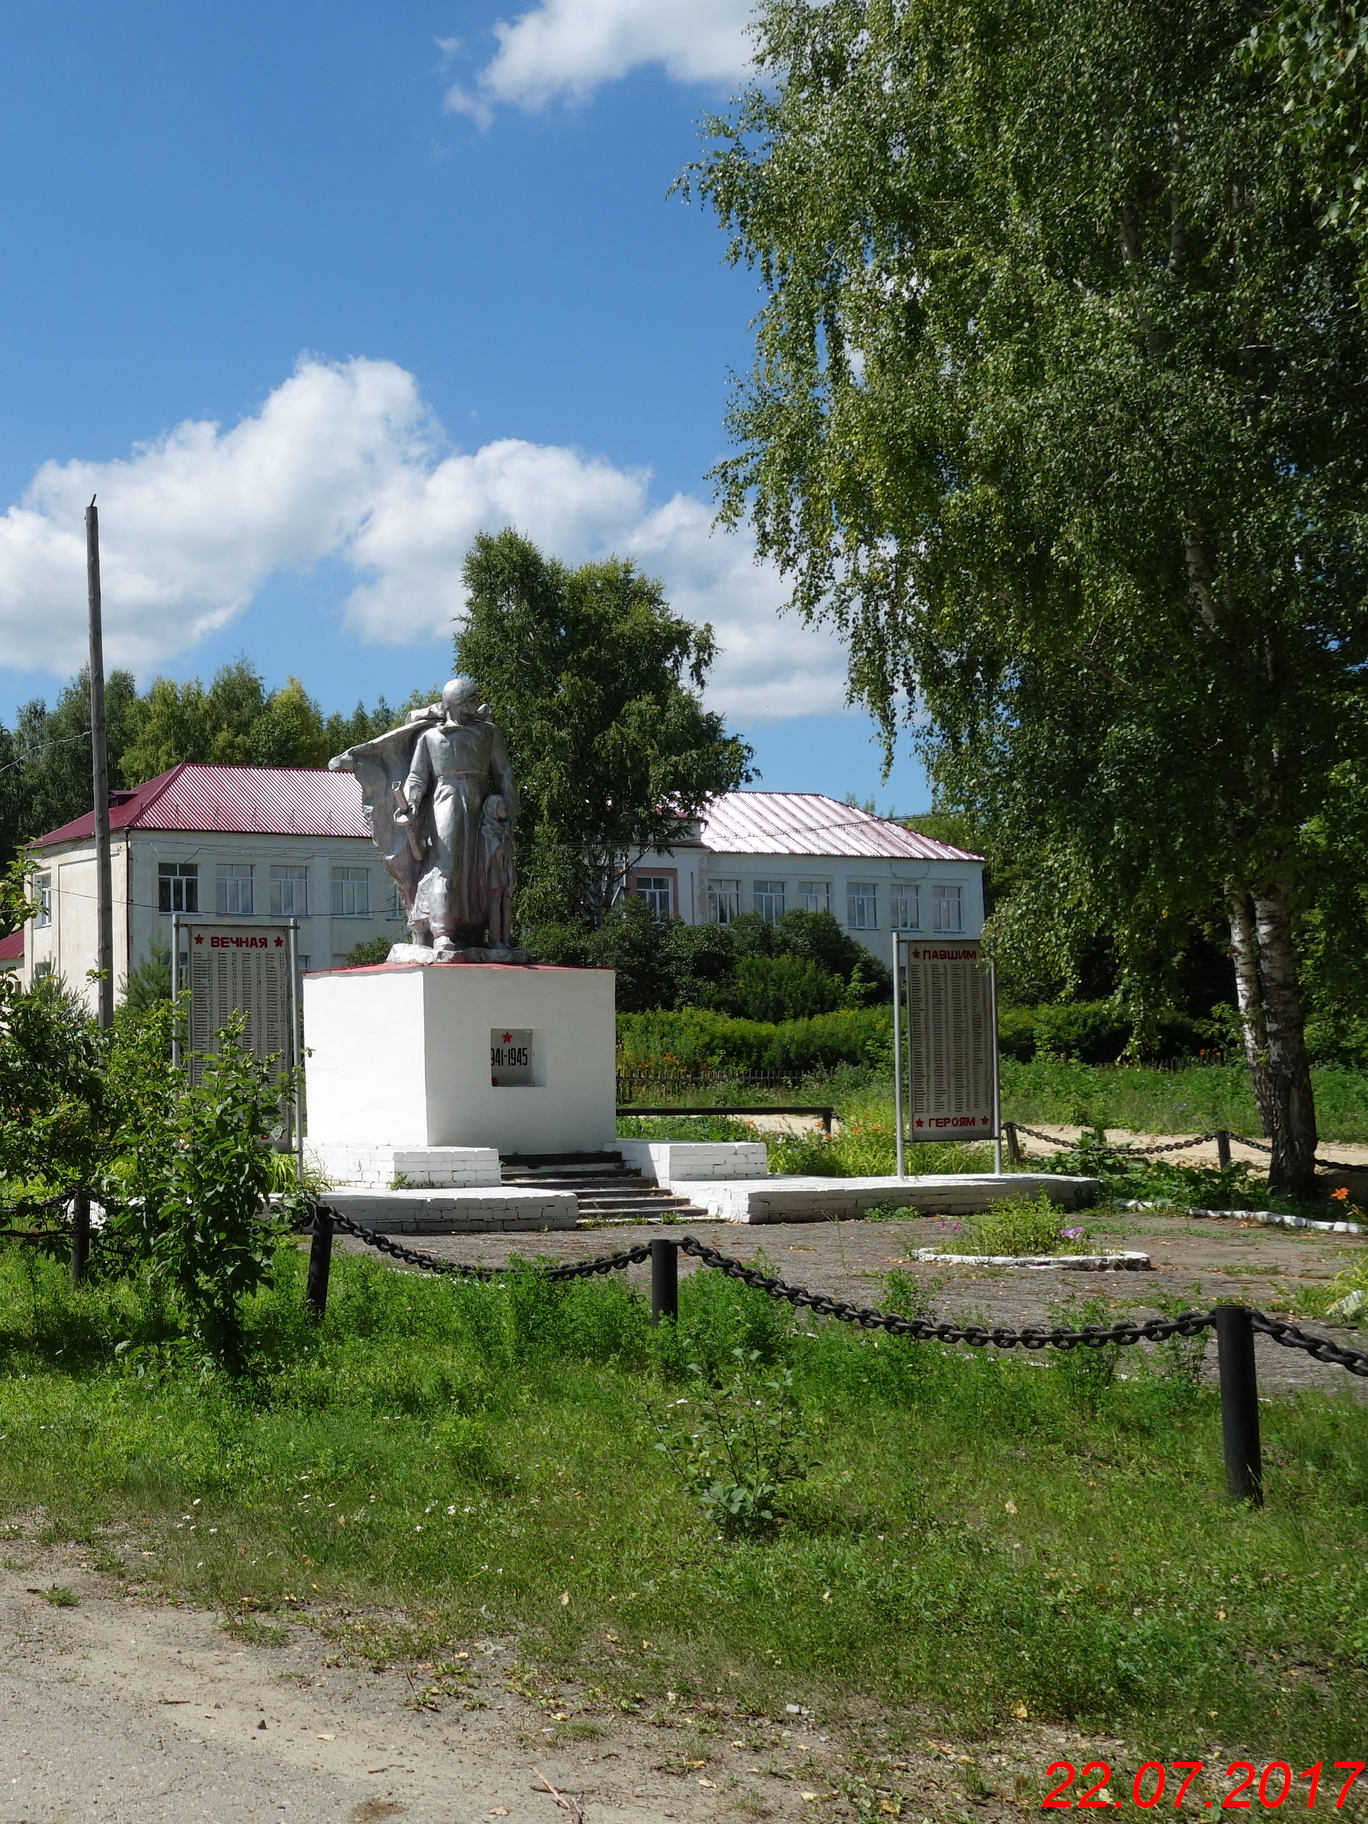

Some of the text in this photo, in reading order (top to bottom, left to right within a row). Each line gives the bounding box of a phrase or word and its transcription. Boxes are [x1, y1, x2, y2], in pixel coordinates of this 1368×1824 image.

[210, 936, 268, 948] ВЕЧНАЯ
[922, 950, 977, 960] ПАВШИМ
[928, 1117, 976, 1128] ГЕРОЯМ
